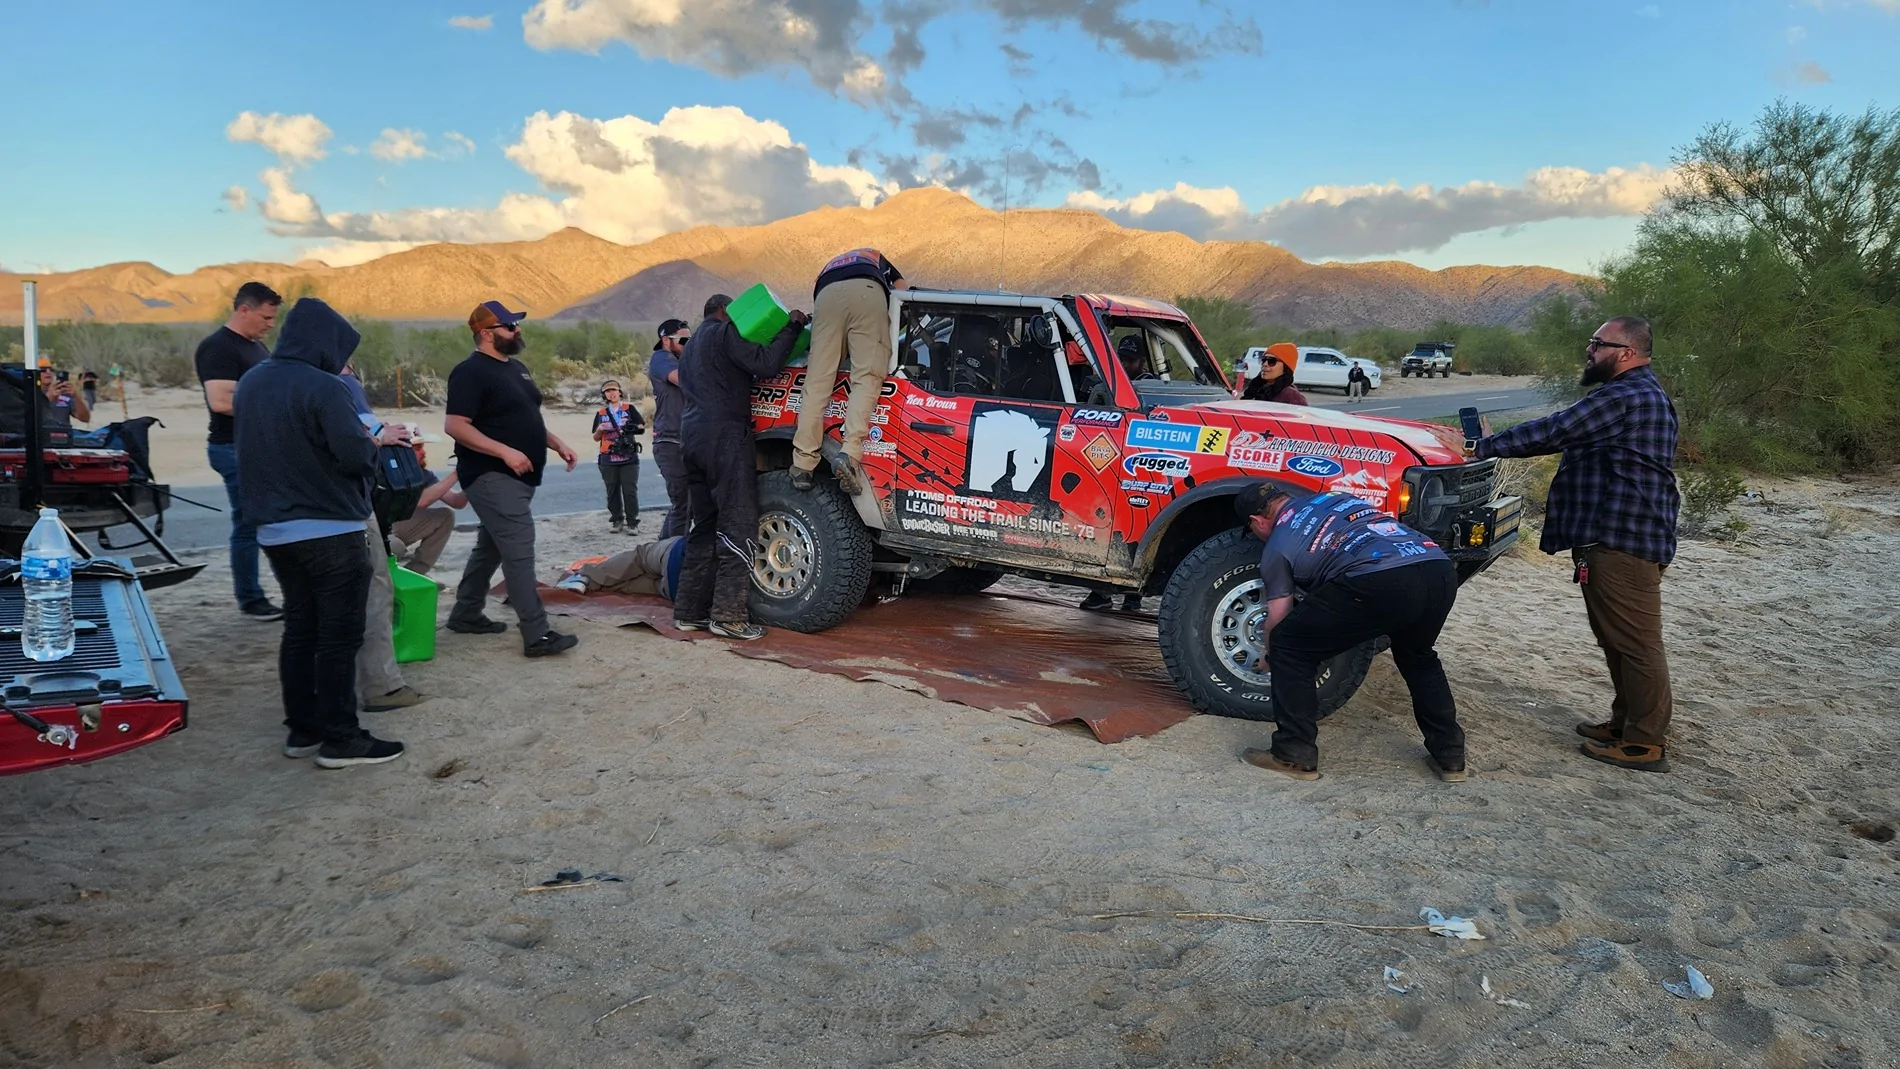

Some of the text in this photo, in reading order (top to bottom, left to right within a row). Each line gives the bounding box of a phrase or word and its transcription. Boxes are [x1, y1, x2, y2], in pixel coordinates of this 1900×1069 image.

[751, 403, 783, 412] GRAVITY
[925, 396, 957, 410] Brown
[1071, 418, 1117, 427] PERFORMANCE
[1073, 409, 1122, 421] FORD
[1136, 427, 1192, 443] BILSTEIN
[1091, 452, 1110, 460] PITS
[1232, 448, 1281, 464] SCORE
[1268, 437, 1397, 465] ARMADILLO DESIGNS
[1296, 458, 1331, 474] Ford
[946, 494, 998, 509] OFFROAD
[905, 499, 959, 519] LEADING
[961, 508, 986, 523] THE
[988, 512, 1026, 529] TRAIL
[1028, 518, 1069, 536] SINCE
[953, 526, 998, 538] METHOD
[1213, 563, 1261, 590] BFGoo
[1210, 673, 1234, 694] T/A
